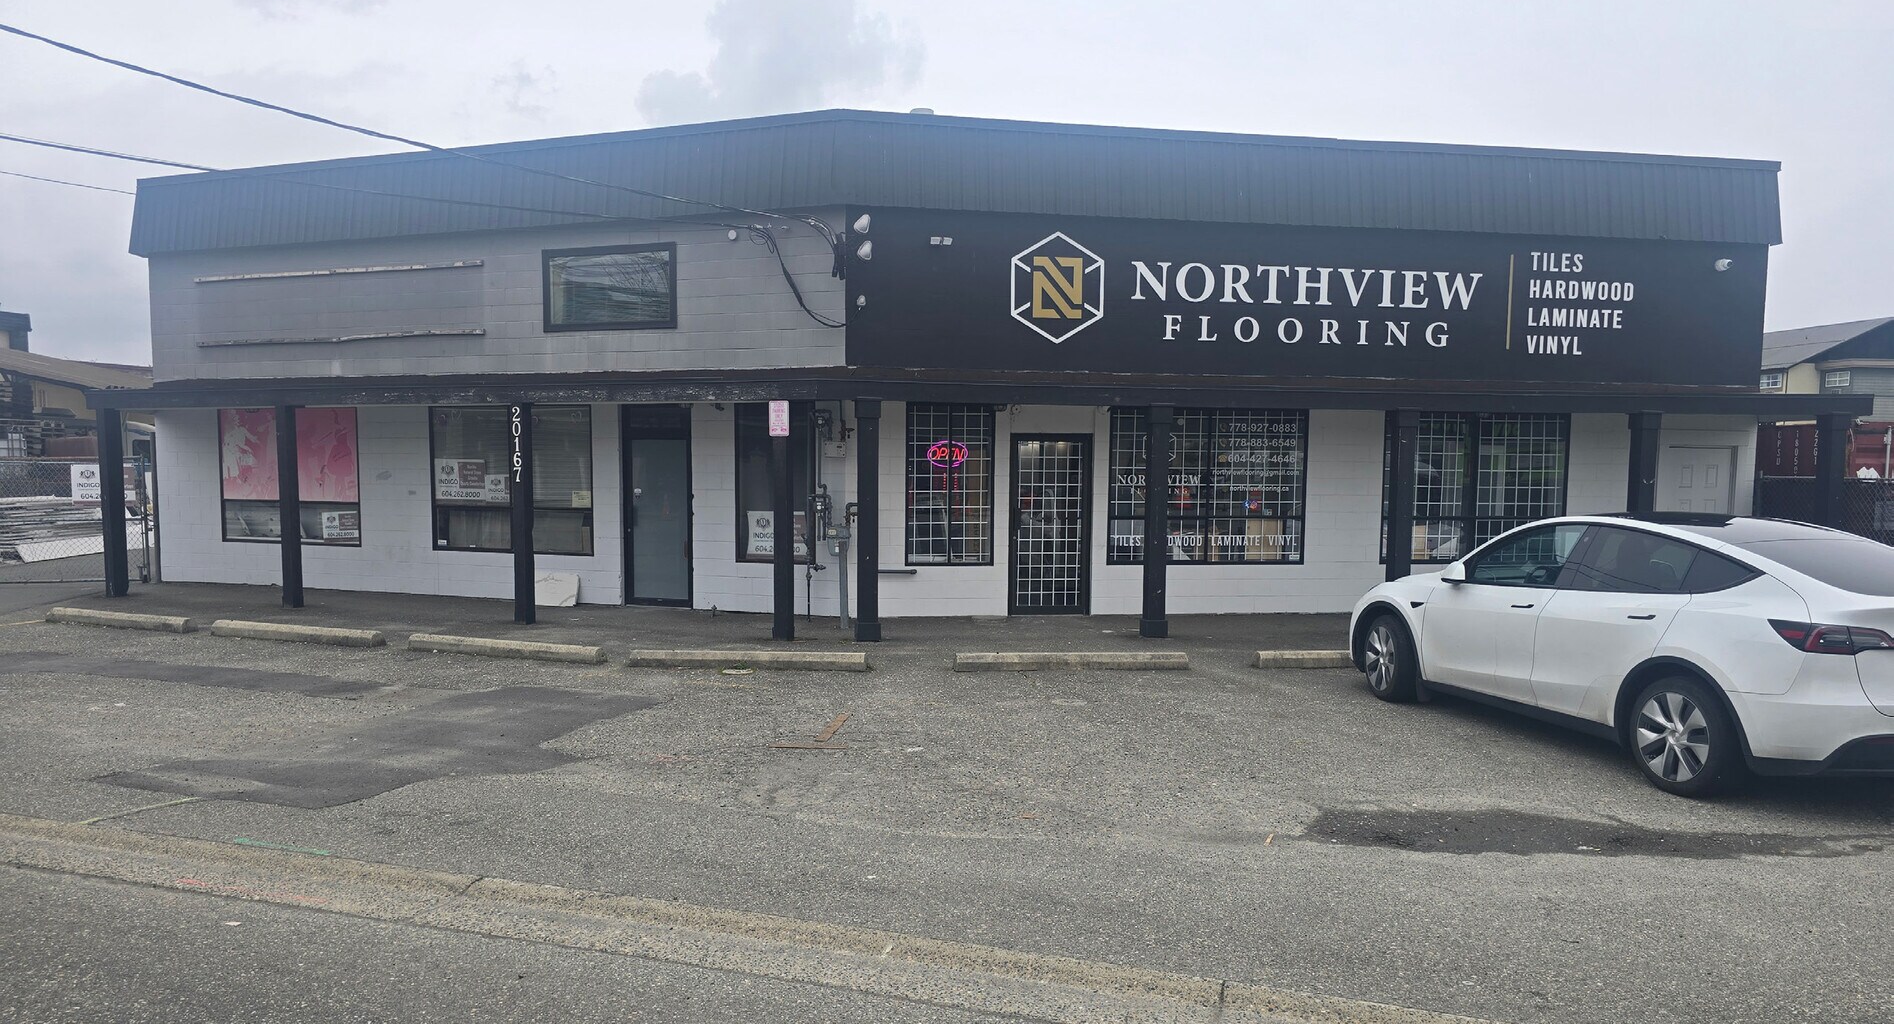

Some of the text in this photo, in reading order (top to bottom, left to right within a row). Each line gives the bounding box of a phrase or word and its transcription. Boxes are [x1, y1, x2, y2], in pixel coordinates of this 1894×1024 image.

[1530, 251, 1584, 274] TILES
[1130, 260, 1484, 311] NORTHVIEW
[1528, 279, 1635, 302] HARDWOOD
[1527, 307, 1623, 329] LAMINATE
[1162, 314, 1450, 348] FLOORING
[1526, 334, 1583, 356] VINYL
[1228, 423, 1297, 433] 778-927-0883
[511, 406, 522, 483] 20167
[1228, 438, 1296, 448] 778-883-6549
[1227, 454, 1296, 464] 604-427-4646
[1117, 474, 1202, 486] NORVIEW
[441, 490, 481, 498] 604.262.8000
[1110, 535, 1142, 547] TILES
[1211, 535, 1261, 547] LAMINATE
[1267, 535, 1298, 546] VINYL
